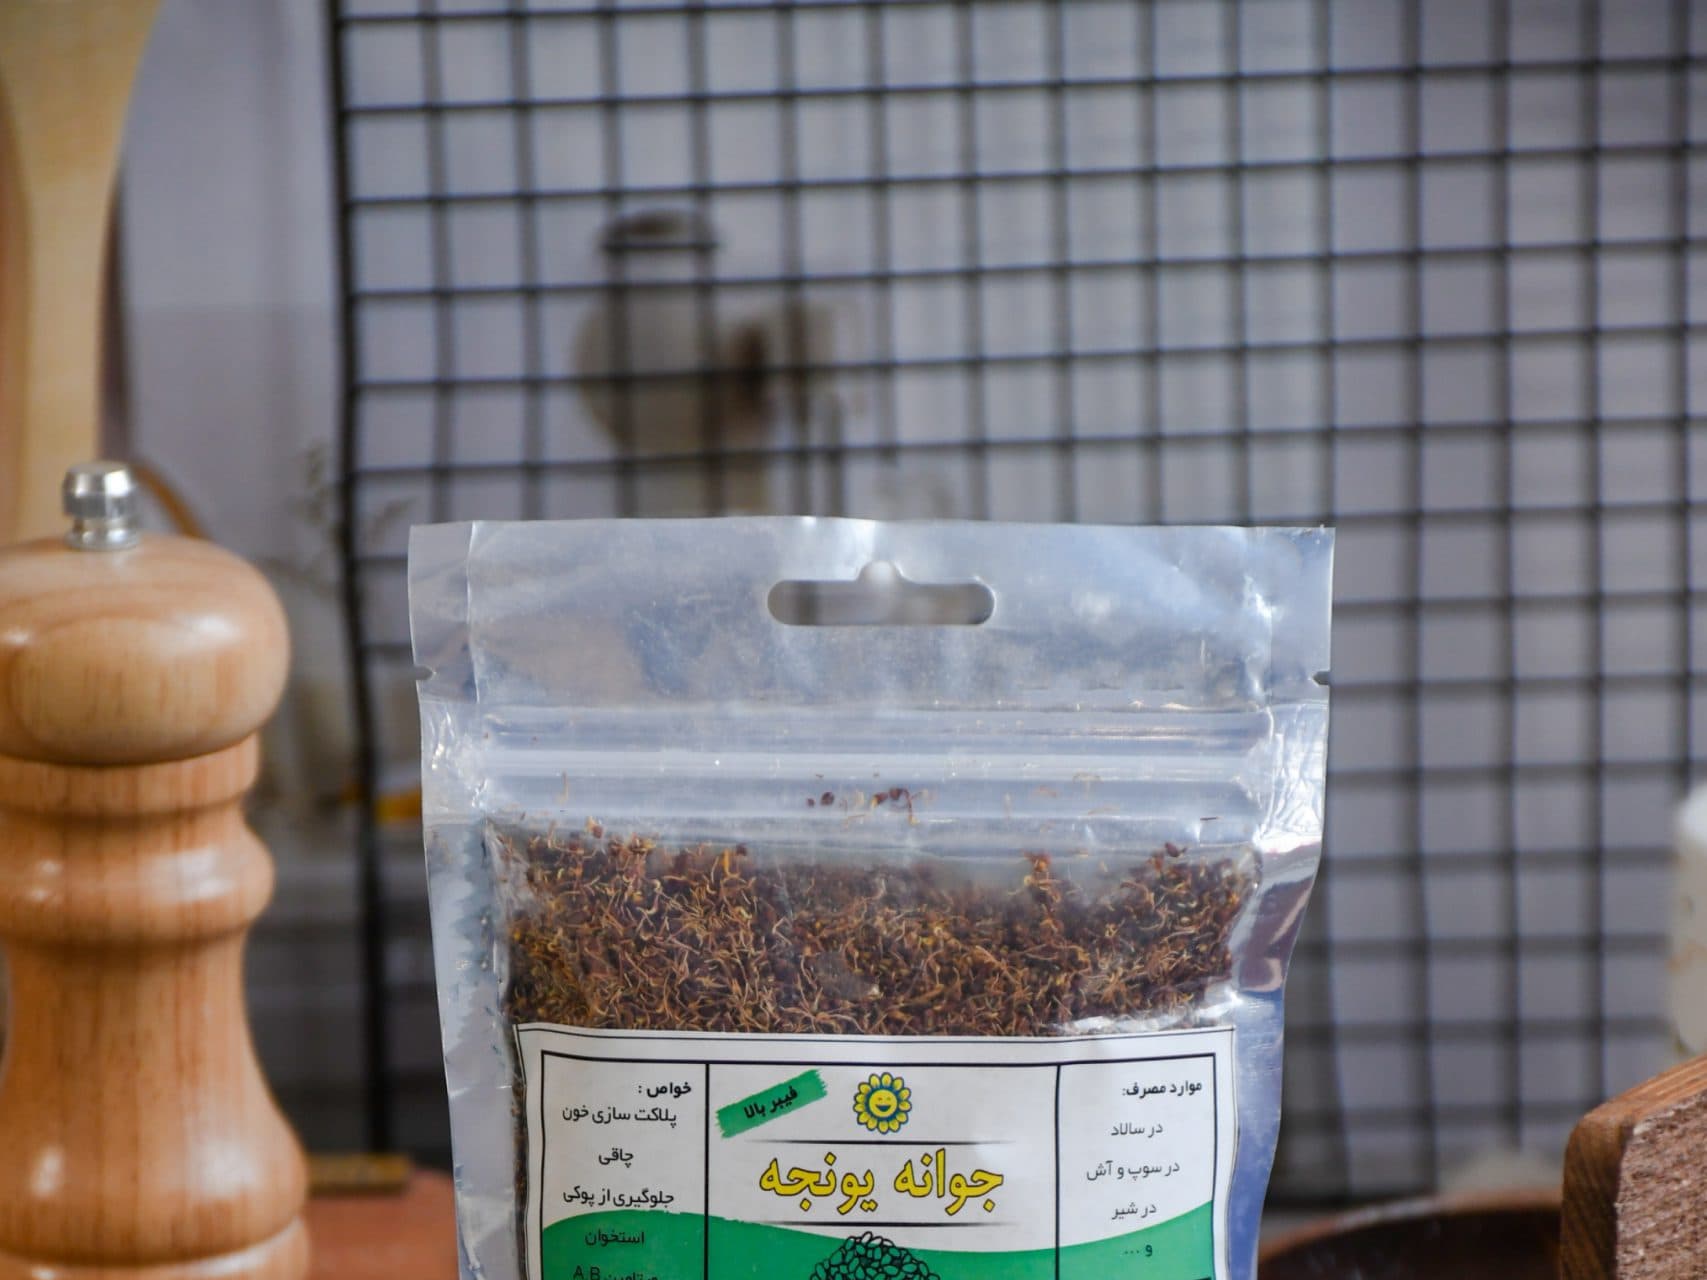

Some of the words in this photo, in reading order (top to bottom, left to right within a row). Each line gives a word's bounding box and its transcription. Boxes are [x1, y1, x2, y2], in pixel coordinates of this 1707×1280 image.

[647, 1082, 692, 1098] خواص
[1122, 1082, 1166, 1099] مصرف:
[1170, 1081, 1202, 1096] موارد
[769, 1085, 798, 1114] فیبر
[562, 1106, 589, 1122] خون
[592, 1106, 630, 1124] سازی
[634, 1108, 677, 1128] پلاکت
[743, 1102, 766, 1119] بالا
[1111, 1122, 1145, 1136] سالاد
[1148, 1124, 1163, 1138] در
[598, 1148, 633, 1168] چاقی
[1087, 1160, 1113, 1180] آش
[1117, 1166, 1124, 1179] و
[1128, 1165, 1162, 1181] سوپ
[1165, 1162, 1180, 1176] در
[759, 1152, 875, 1215] یونجه
[893, 1148, 1004, 1216] جوانه
[563, 1186, 594, 1206] پوکی
[598, 1189, 611, 1206] از
[613, 1188, 674, 1208] جلوگیری
[1112, 1202, 1138, 1219] شیر
[1141, 1203, 1157, 1218] در
[585, 1228, 645, 1247] استخوان
